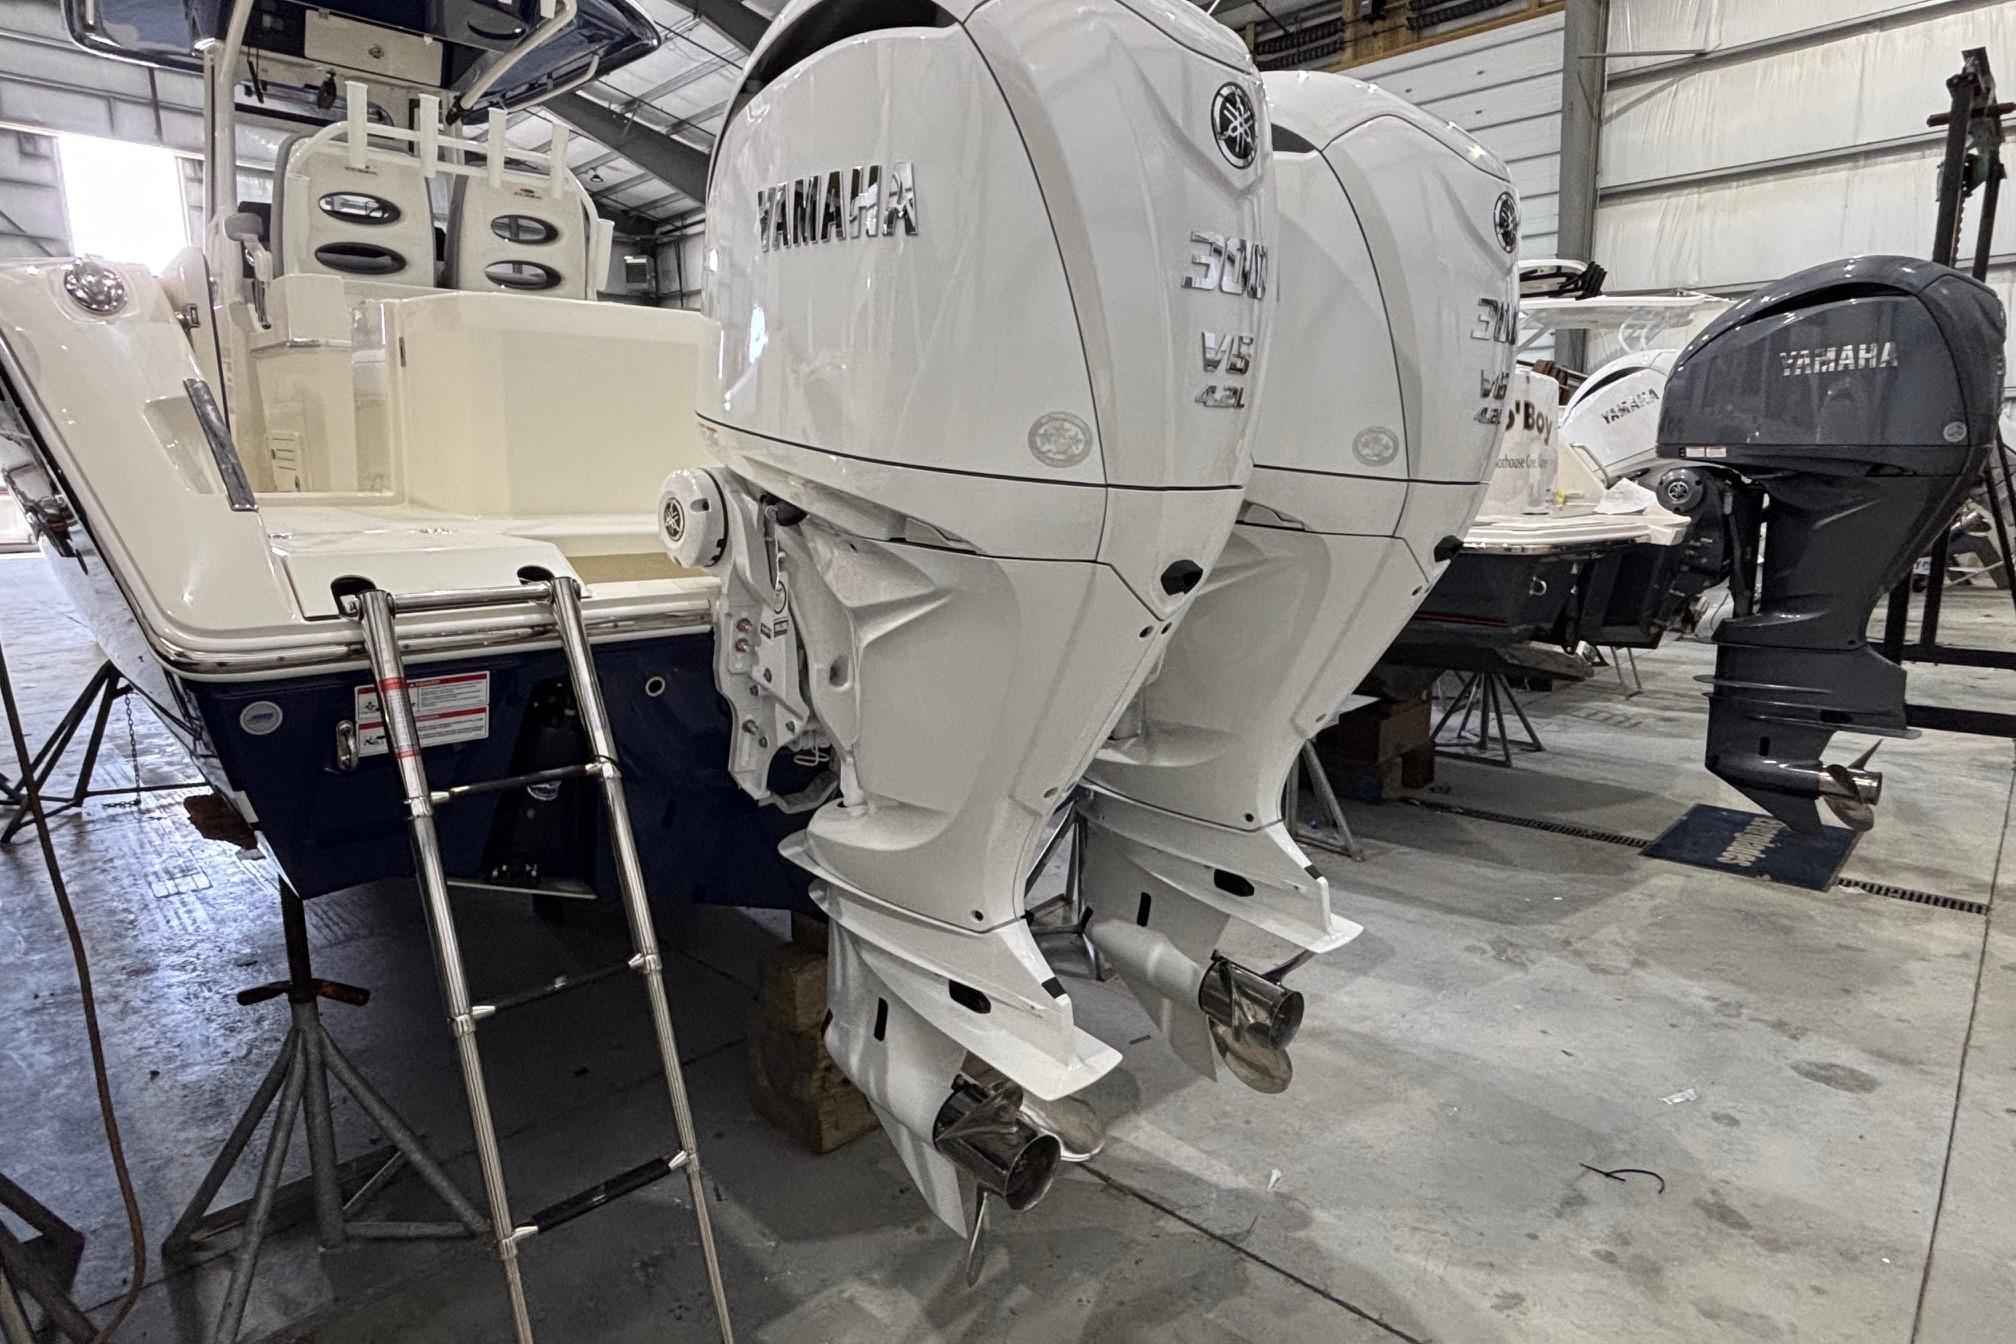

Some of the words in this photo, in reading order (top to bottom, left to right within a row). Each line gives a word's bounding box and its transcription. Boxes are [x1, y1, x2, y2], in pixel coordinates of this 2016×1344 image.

[758, 162, 919, 252] YAMAHA
[1181, 230, 1268, 300] 300
[1202, 332, 1254, 375] V6
[1780, 341, 1899, 376] YAMAHA
[1601, 388, 1660, 424] YAMAHA
